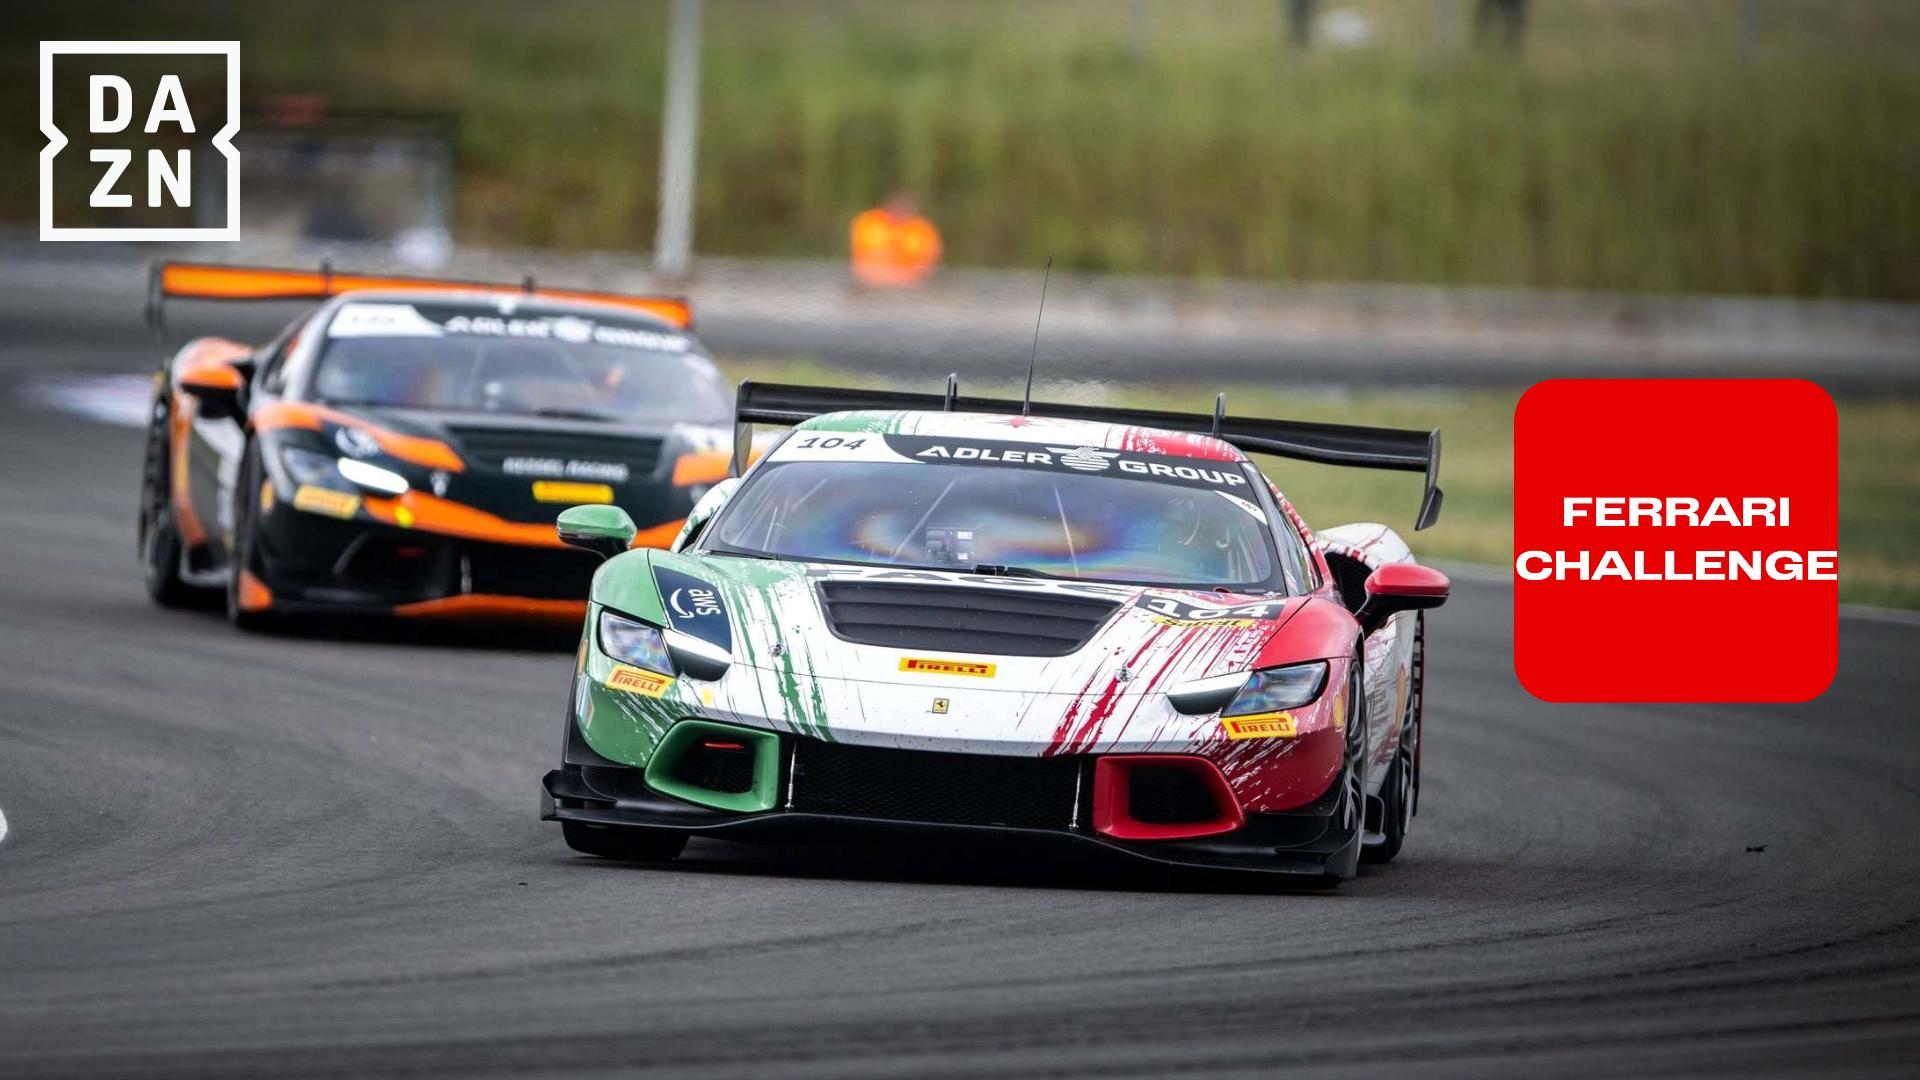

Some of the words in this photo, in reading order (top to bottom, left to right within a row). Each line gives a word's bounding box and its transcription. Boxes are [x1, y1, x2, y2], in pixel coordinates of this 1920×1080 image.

[797, 437, 866, 450] 104
[915, 445, 1053, 465] ADLER
[1118, 460, 1246, 486] GROUP
[688, 589, 721, 615] aws
[1147, 599, 1269, 619] 104
[907, 659, 987, 674] PIRELLI
[612, 669, 665, 692] PIRELLI
[1231, 717, 1289, 733] PIRELLI
